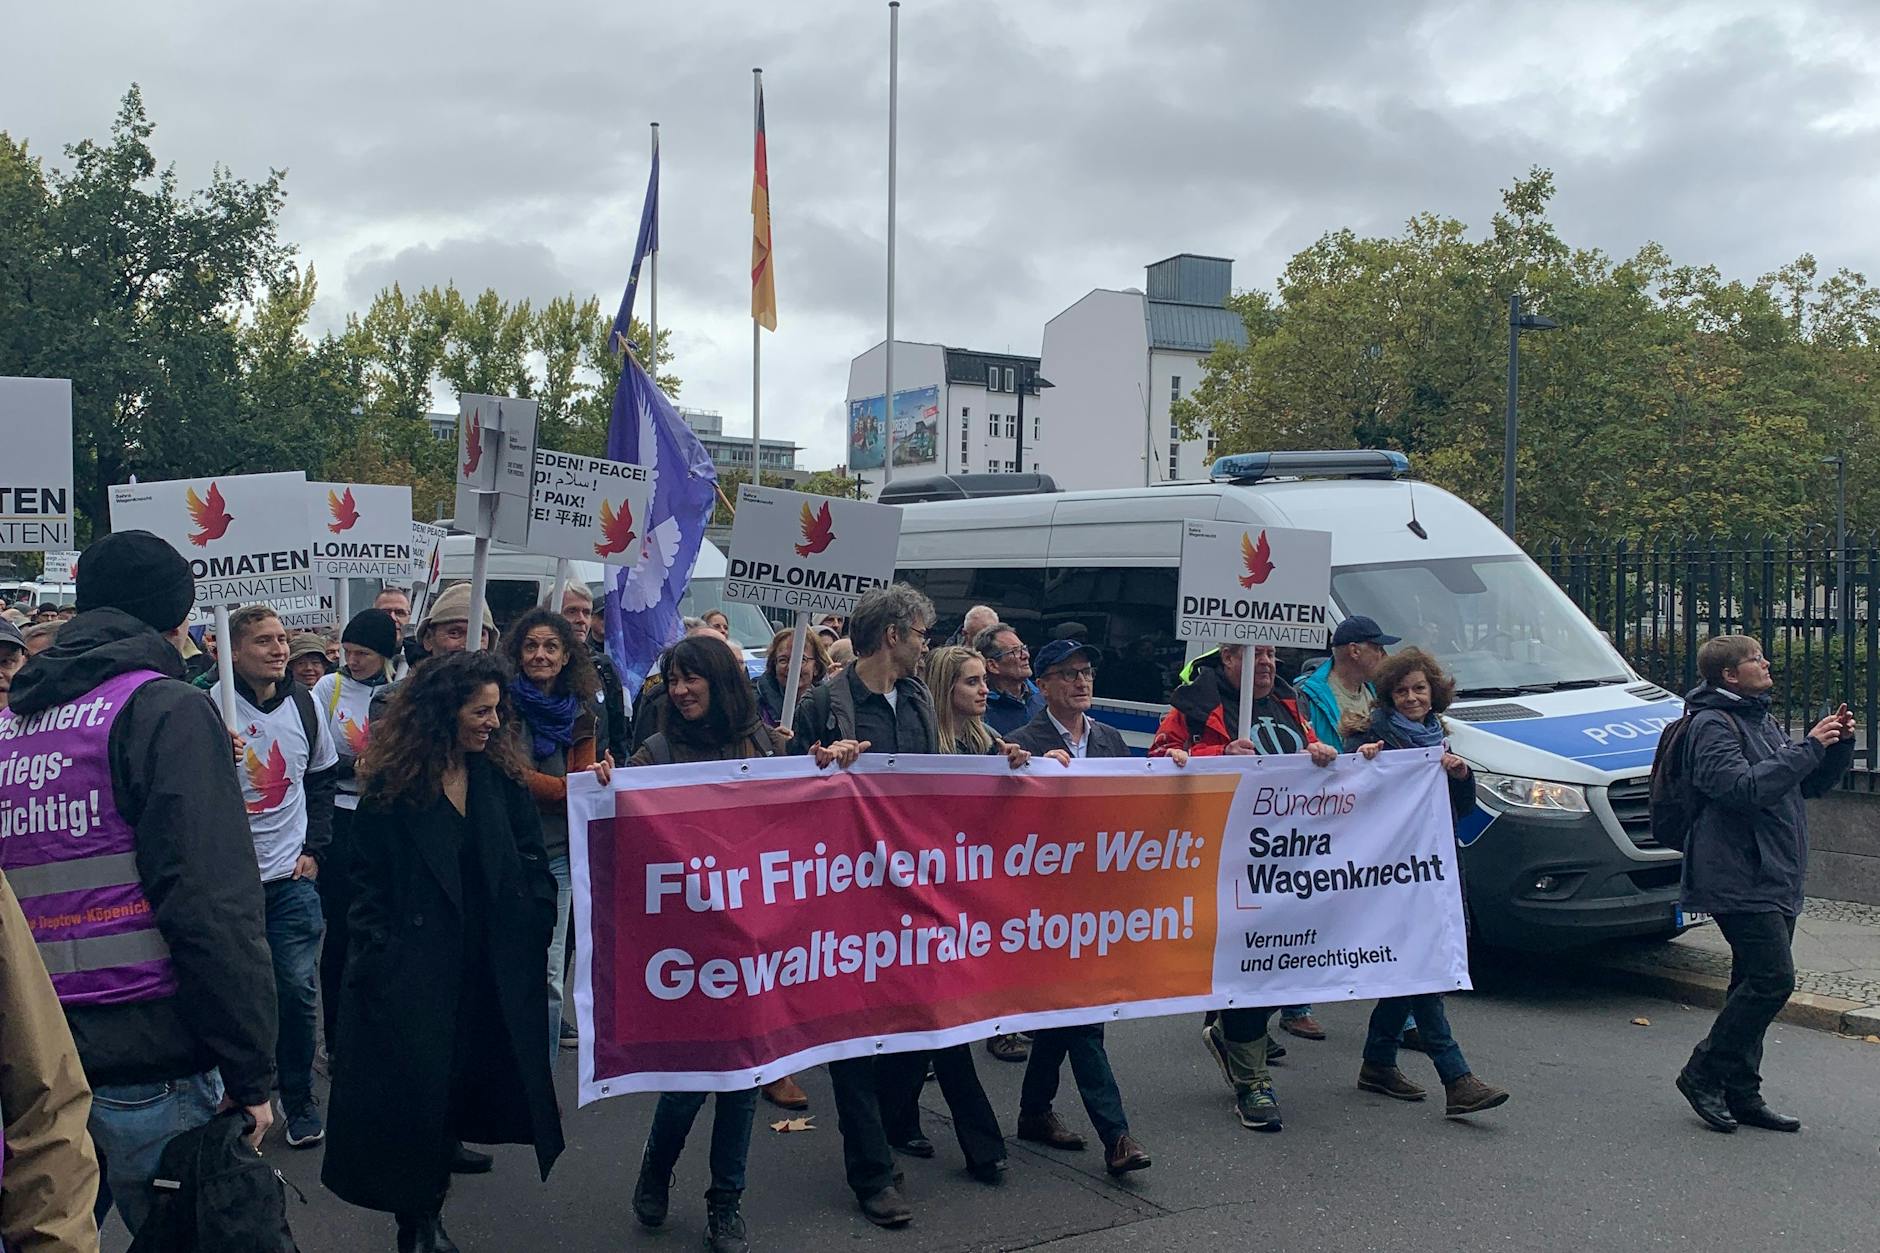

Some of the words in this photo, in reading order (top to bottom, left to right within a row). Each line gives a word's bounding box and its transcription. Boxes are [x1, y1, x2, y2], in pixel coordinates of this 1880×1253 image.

[589, 461, 647, 481] PEACE!
[544, 491, 585, 508] PAIX!
[555, 509, 592, 527] 平和!
[0, 522, 67, 543] TEN!
[326, 561, 411, 575] GRANATEN!
[730, 559, 889, 595] DIPLOMATEN
[194, 575, 313, 601] GRANATEN!
[726, 582, 783, 603] STATT
[1183, 596, 1325, 624] DIPLOMATEN
[1181, 620, 1231, 638] STATT
[1234, 624, 1325, 644] GRANATEN!
[1252, 787, 1356, 817] Bündnis
[1248, 827, 1331, 858] Sahra
[645, 855, 749, 914] Für
[759, 840, 947, 905] Frieden
[955, 831, 994, 882] in
[1004, 833, 1085, 877] der
[1096, 829, 1205, 873] Welt:
[1247, 854, 1445, 899] Wagenknecht
[645, 912, 992, 1000] Gewaltspirale
[999, 896, 1194, 959] stoppen!
[1244, 929, 1317, 949] Vernunft
[1240, 956, 1273, 972] und
[1277, 945, 1398, 970] Gerechtigkeit.
